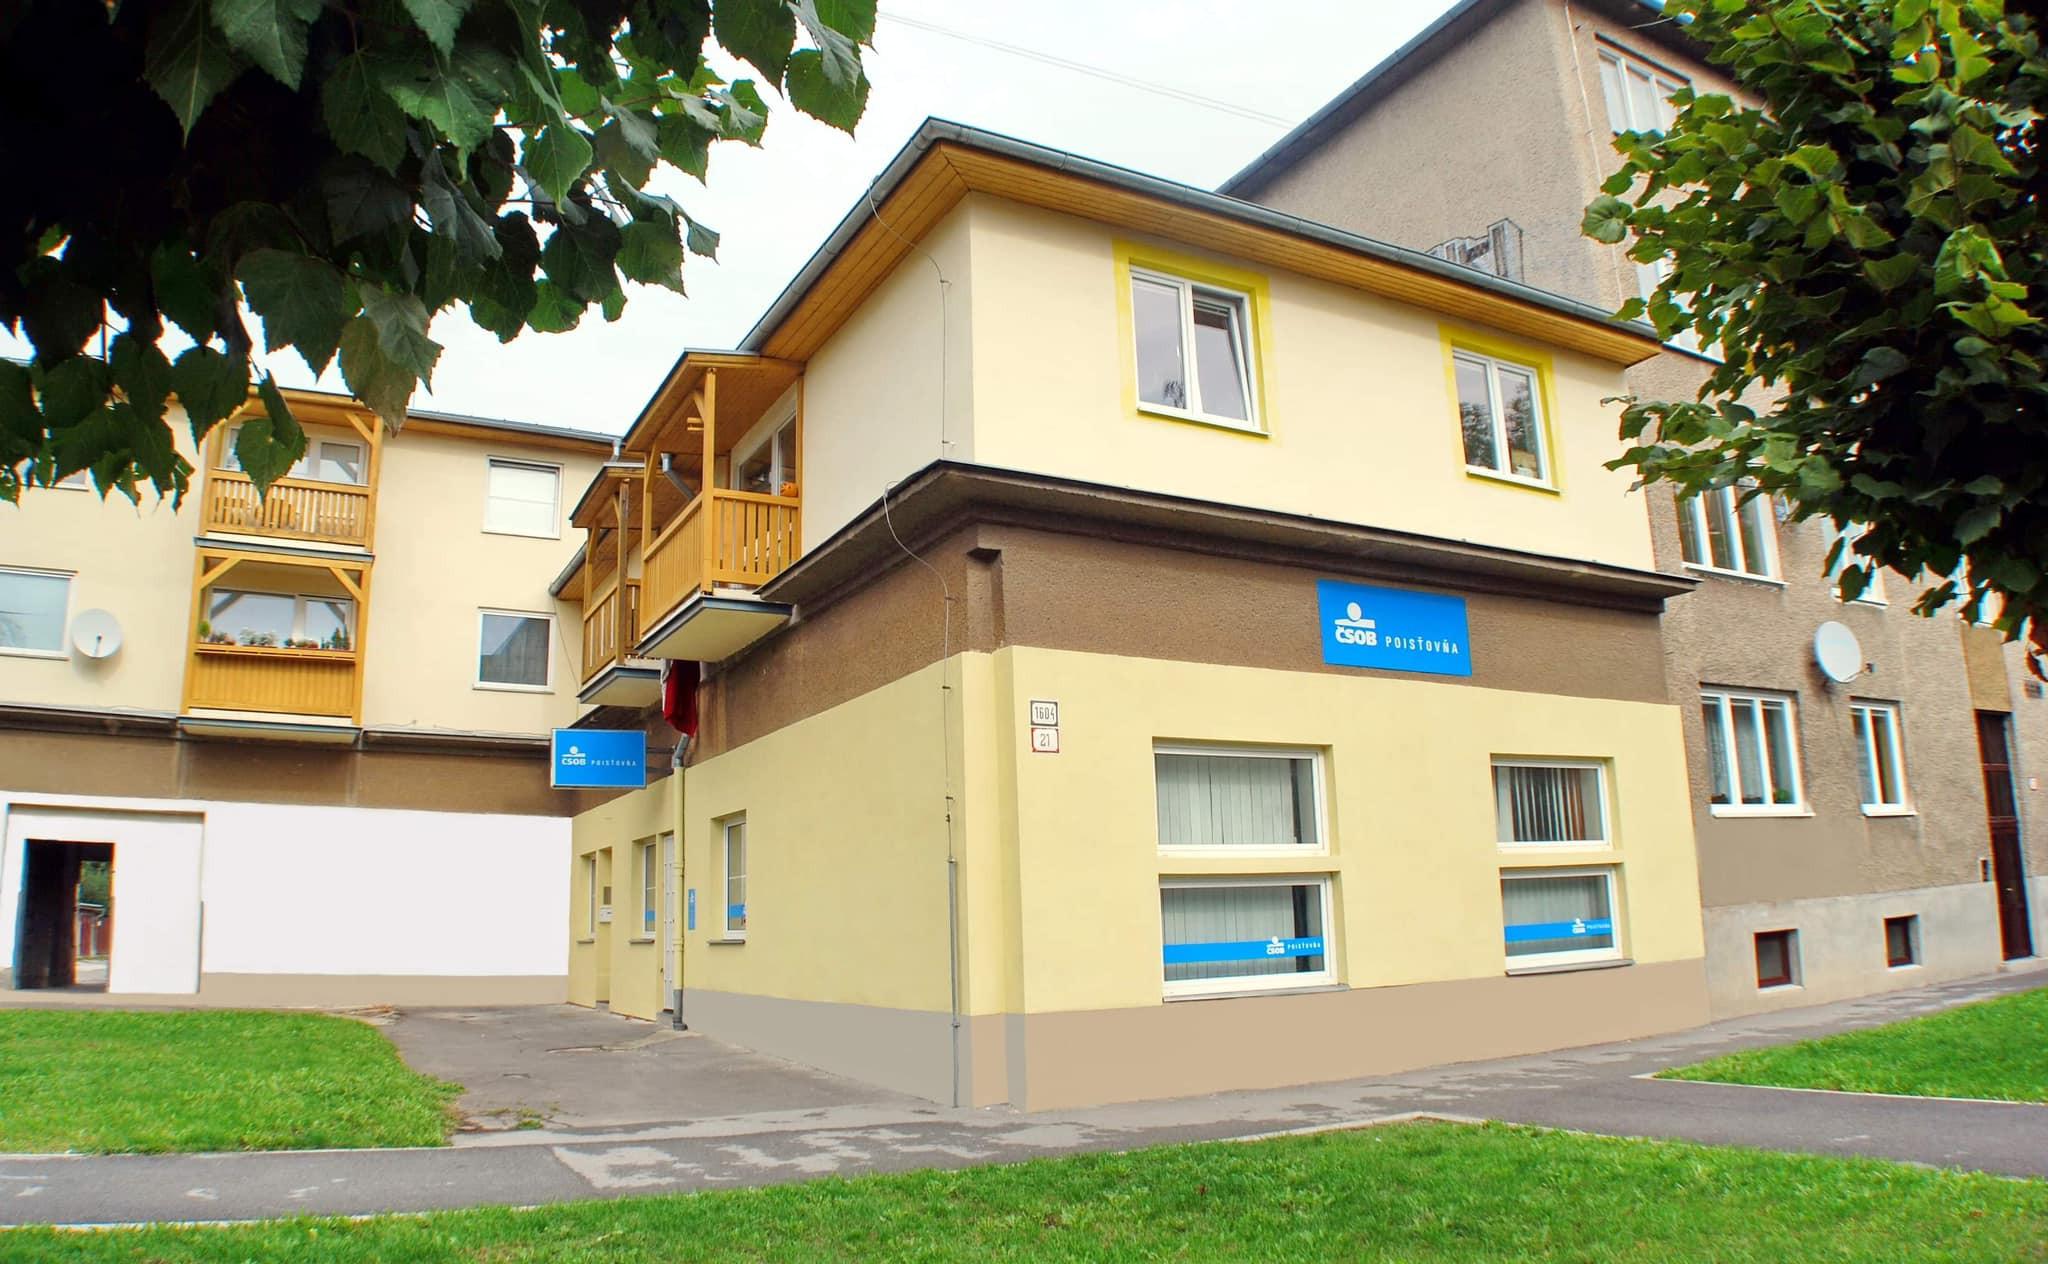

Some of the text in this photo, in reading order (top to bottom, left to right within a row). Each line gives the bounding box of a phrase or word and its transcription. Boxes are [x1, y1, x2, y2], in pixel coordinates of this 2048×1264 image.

[1335, 626, 1460, 654] ČSOB POISŤOVŇA
[1040, 733, 1050, 747] 21
